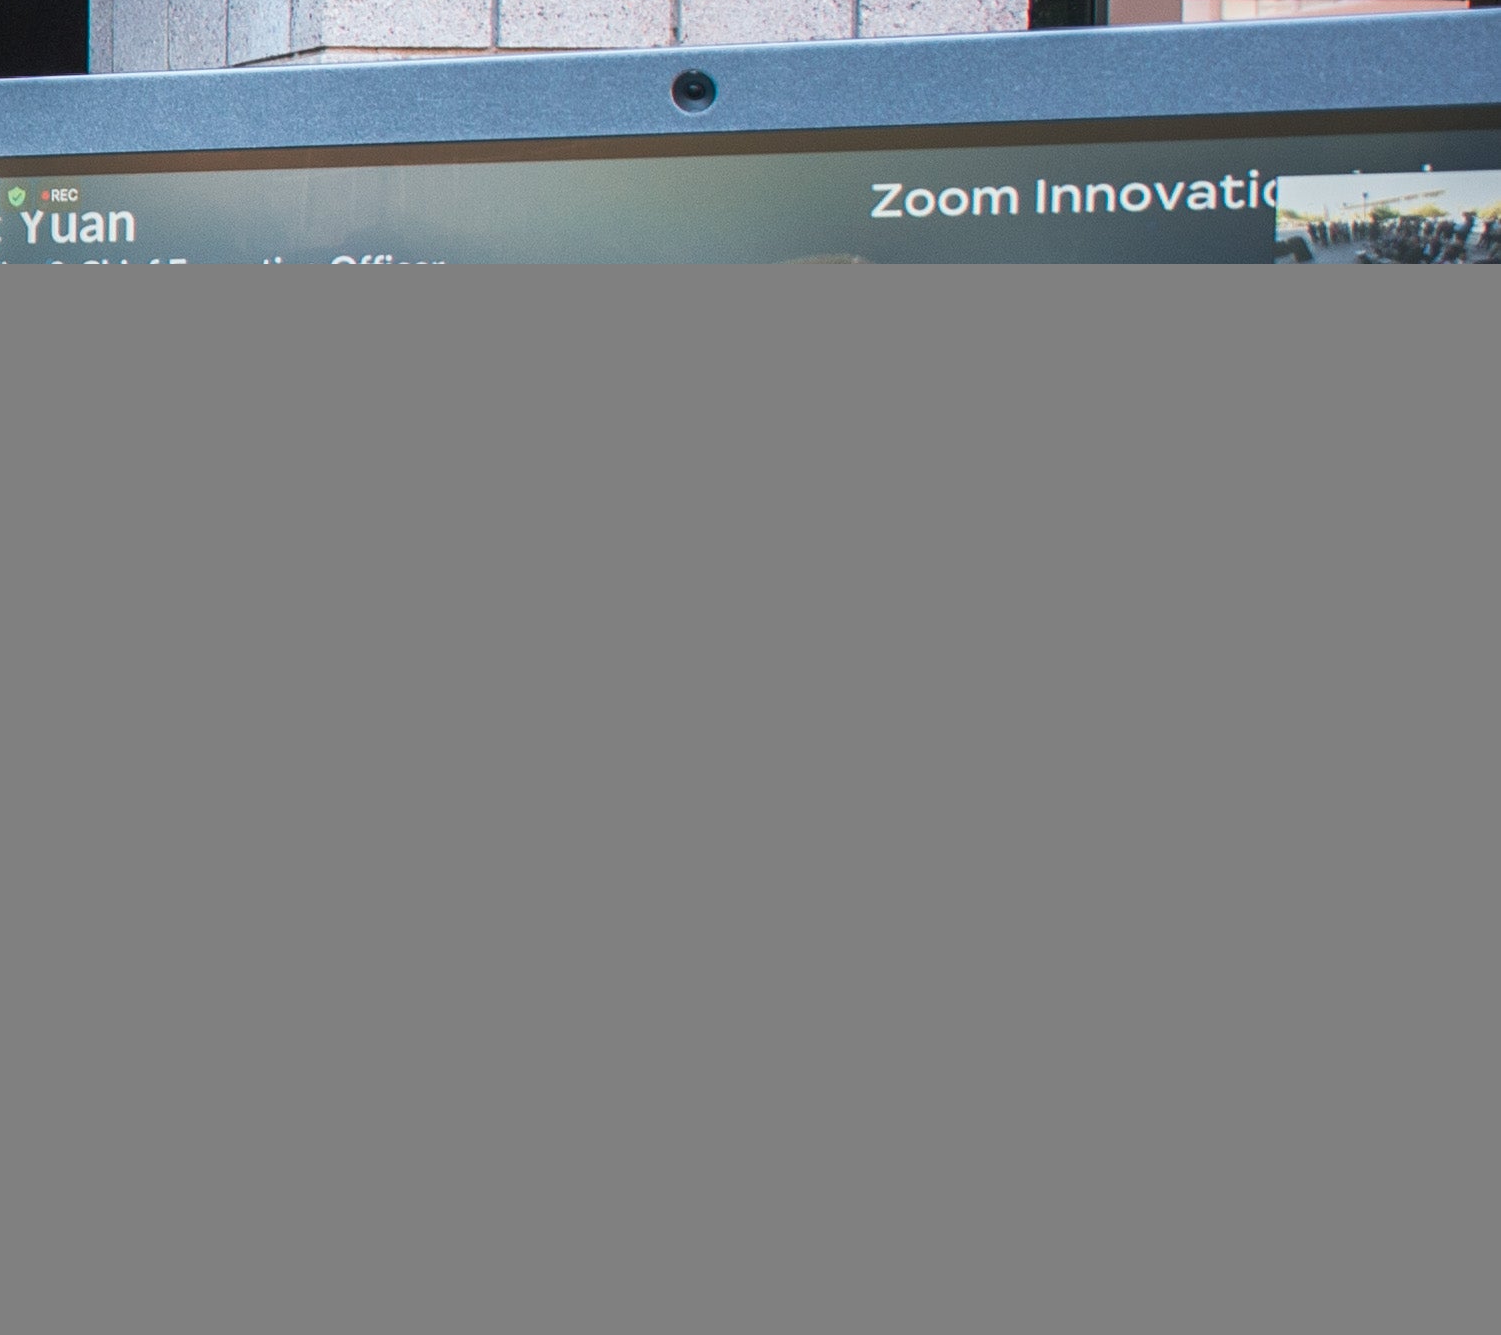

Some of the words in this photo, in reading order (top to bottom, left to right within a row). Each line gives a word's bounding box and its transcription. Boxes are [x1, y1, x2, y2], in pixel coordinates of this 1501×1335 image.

[51, 188, 79, 202] REC
[869, 181, 1020, 218] Zoom
[19, 209, 136, 245] Yuan
